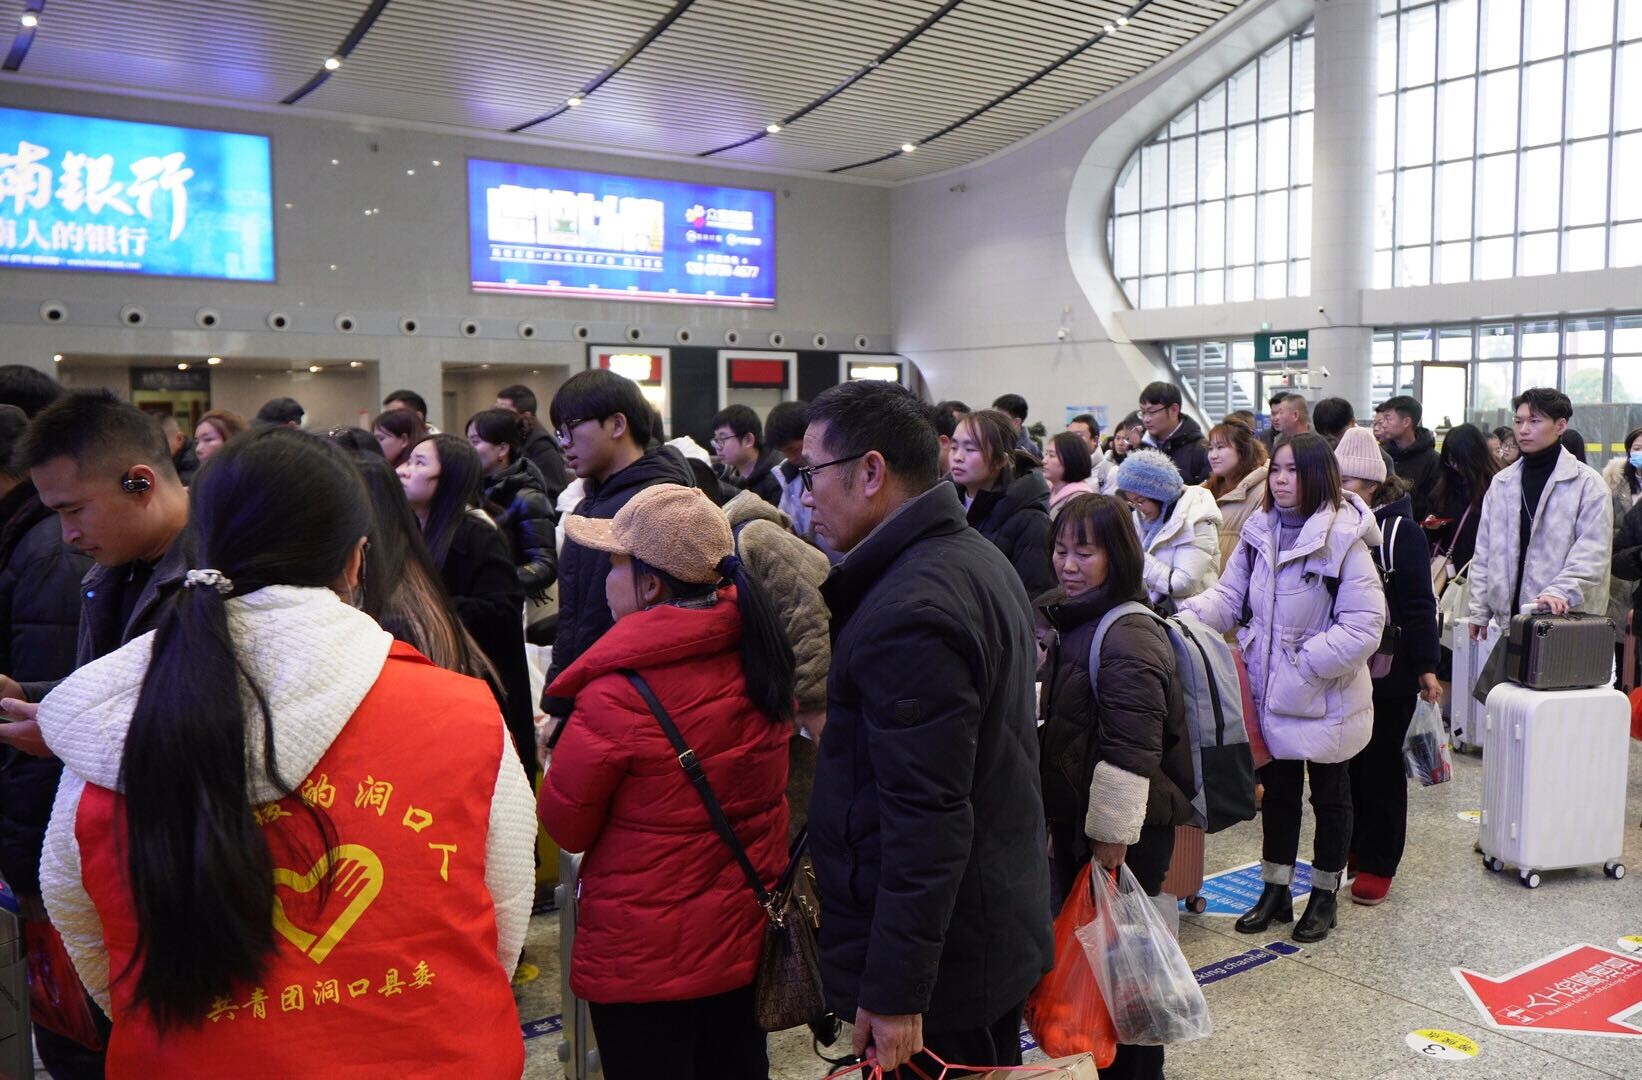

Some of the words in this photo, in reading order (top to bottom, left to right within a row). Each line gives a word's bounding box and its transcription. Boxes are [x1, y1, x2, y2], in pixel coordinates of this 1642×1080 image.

[1289, 338, 1306, 350] 出口
[207, 960, 436, 1022] 共青团洞口县委
[1422, 1043, 1446, 1055] 3
